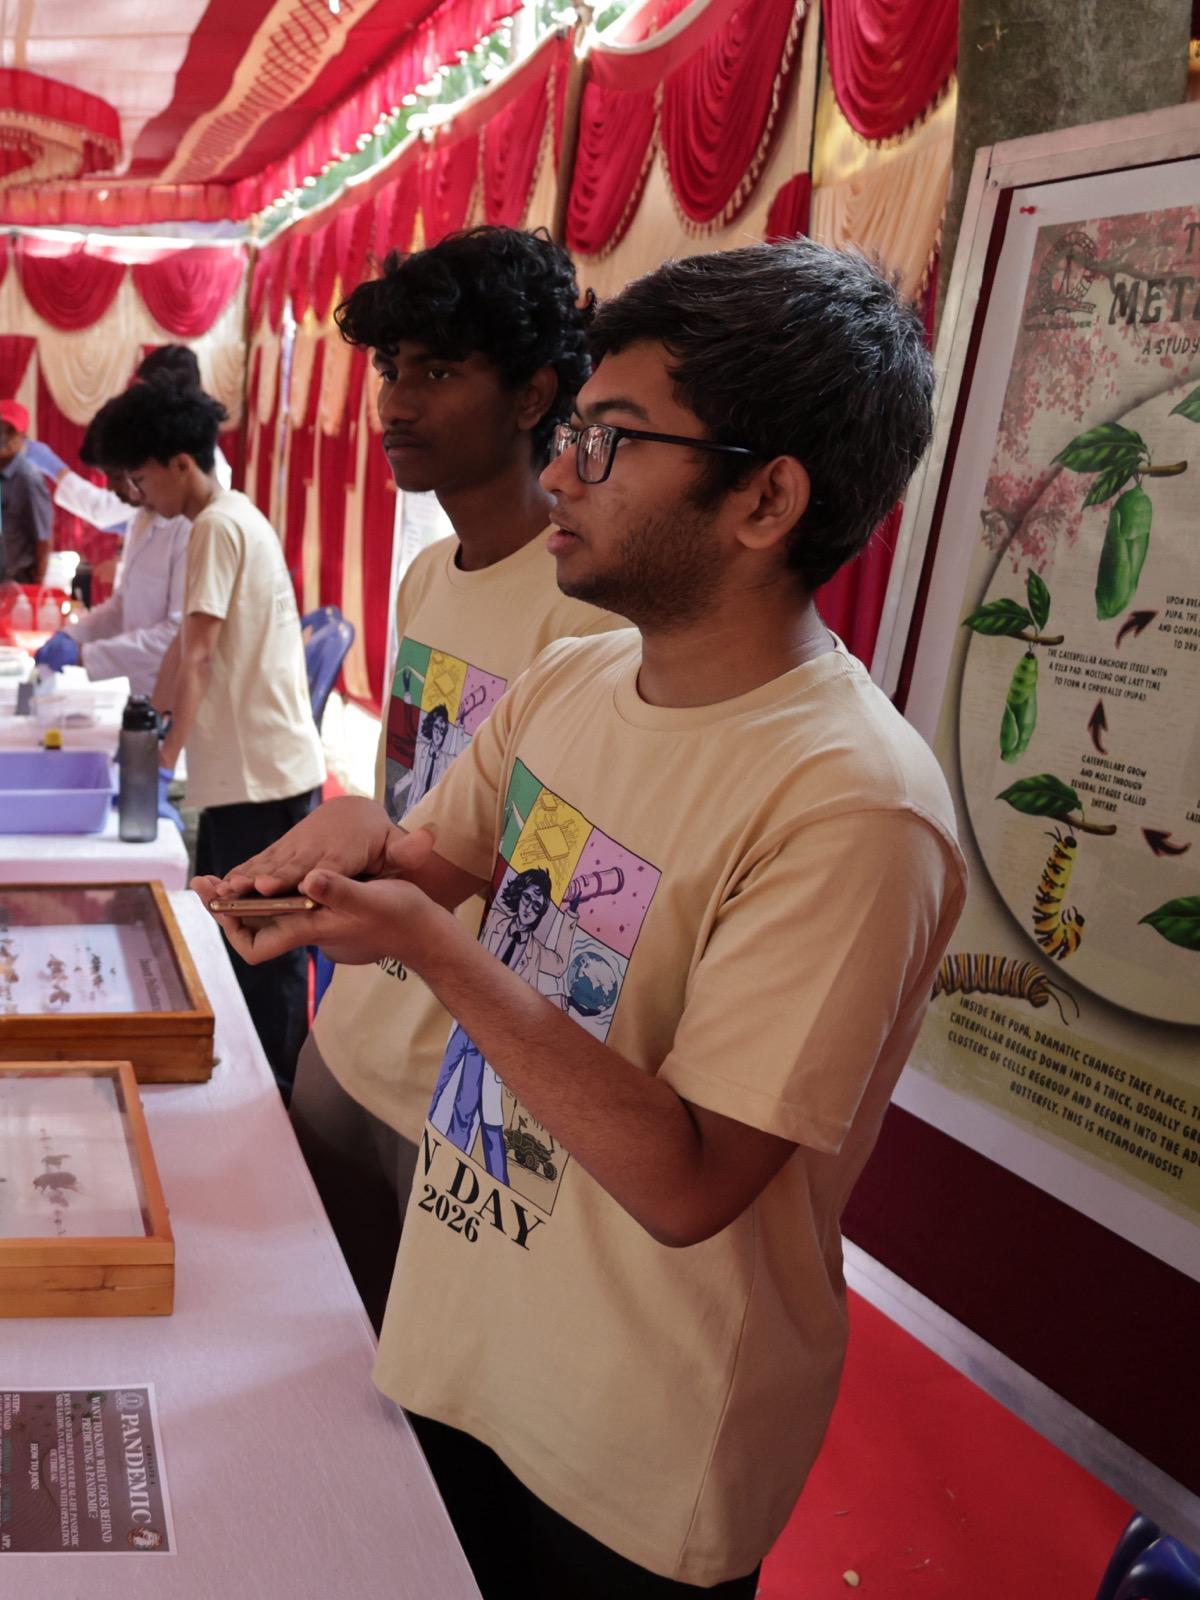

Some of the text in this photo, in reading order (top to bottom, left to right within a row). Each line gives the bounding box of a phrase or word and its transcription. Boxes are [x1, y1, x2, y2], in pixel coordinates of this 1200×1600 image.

[1108, 275, 1200, 325] MET
[1155, 337, 1200, 355] STUDY
[1159, 624, 1171, 632] AND
[1059, 650, 1096, 664] CATERPILLAR
[1099, 657, 1128, 670] ANCHORS
[1152, 667, 1167, 677] WITH
[1085, 669, 1112, 681] MOLTING
[1128, 677, 1144, 687] LAST
[1145, 679, 1160, 691] TIME
[1064, 678, 1080, 688] FORM
[1080, 768, 1142, 790] AND MOLT THROUGH
[1082, 755, 1147, 777] CATERPILLARS GROW
[1071, 779, 1147, 806] SEVERAL STAGES CALLED
[1091, 798, 1117, 812] INSTARS
[377, 954, 407, 982] 026
[960, 997, 989, 1018] INSIDE
[990, 1010, 1007, 1026] THE
[1034, 1030, 1081, 1061] DRAMATIC
[1082, 1054, 1127, 1082] CHANGES
[1128, 1074, 1153, 1096] TAKE
[950, 1012, 1004, 1045] CATERPILLAR
[1005, 1037, 1038, 1062] BREAKS
[1039, 1053, 1067, 1075] DOWN
[1069, 1068, 1092, 1088] INTO
[1136, 1102, 1181, 1132] USUALLY
[990, 1050, 1001, 1063] OF
[1002, 1056, 1027, 1077] CELLS
[1071, 1090, 1092, 1109] AND
[1093, 1101, 1131, 1130] REFORM
[1133, 1121, 1158, 1144] INTO
[1160, 1135, 1180, 1156] THE
[1061, 1106, 1083, 1127] THIS
[1084, 1118, 1095, 1132] IS
[1096, 1126, 1184, 1180] METAMORPHOSIS!
[418, 1183, 480, 1243] 2026
[445, 1157, 546, 1251] DAY
[3, 1394, 11, 1430] DOWNLOAD
[30, 1442, 38, 1459] HOW
[81, 1417, 94, 1463] PREDICTING
[57, 1438, 67, 1487] COLLABORATION
[90, 1396, 112, 1542] WANT TO KNOW WHAT GOES BEHIND
[120, 1414, 152, 1523] PANDEMIC
[59, 1489, 68, 1506] WITH
[85, 1472, 98, 1518] PANDEMIC?
[59, 1507, 69, 1546] OPERATION
[68, 1512, 79, 1546] PANDEMIC
